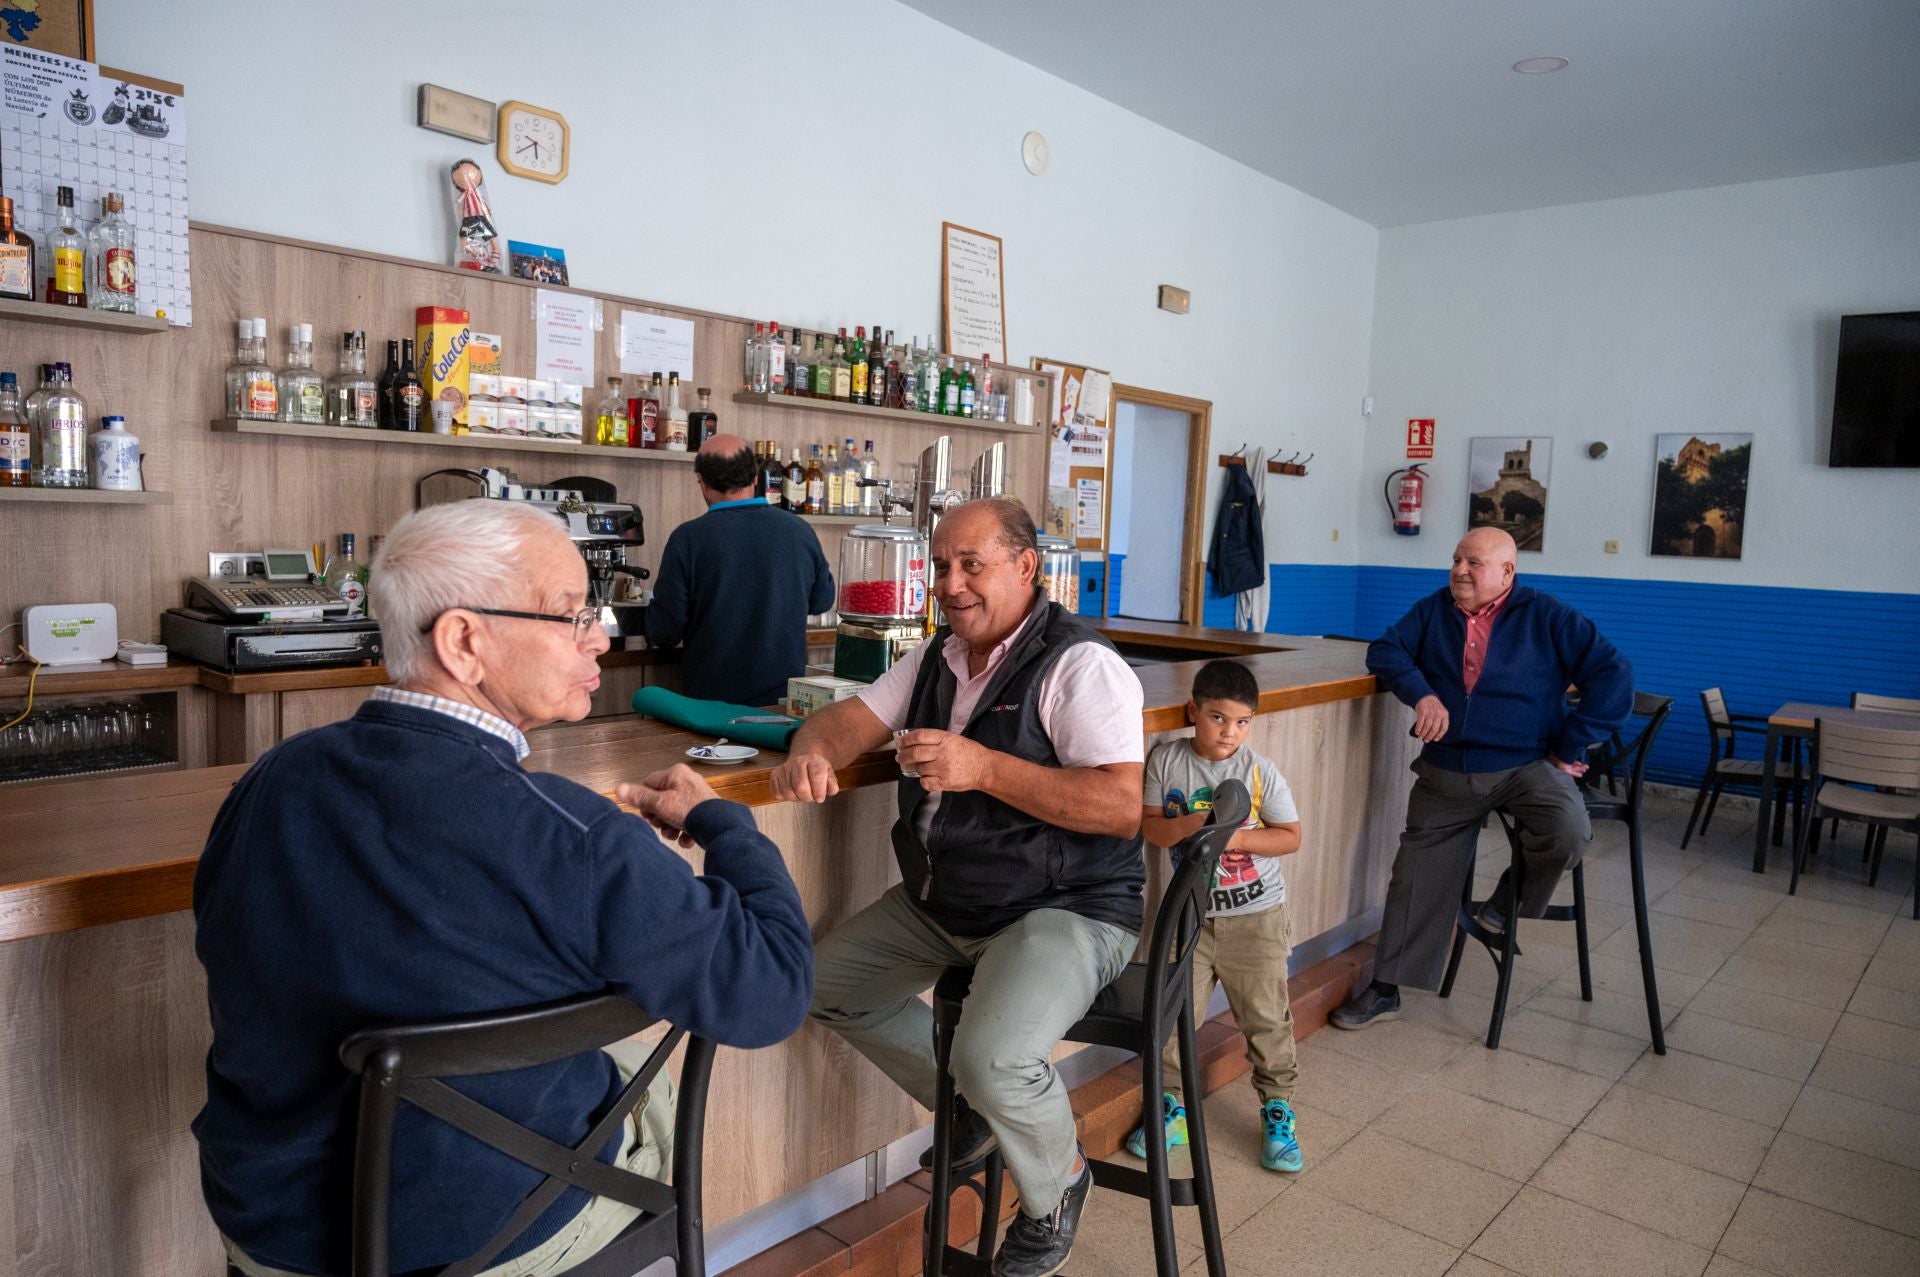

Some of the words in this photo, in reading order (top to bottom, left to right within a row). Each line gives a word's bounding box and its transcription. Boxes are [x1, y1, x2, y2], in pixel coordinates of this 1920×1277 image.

[4, 47, 61, 66] MENESES
[64, 61, 87, 72] F.C.
[5, 59, 31, 68] SORTEO
[58, 70, 78, 79] CESTA
[3, 72, 19, 81] CON
[21, 76, 35, 84] LOS
[36, 79, 51, 87] DOS
[32, 73, 63, 84] NAVIDAD
[4, 79, 39, 92] ÚLTIMOS
[4, 87, 42, 100] NÚMEROS
[5, 102, 34, 113] Navidad
[13, 96, 38, 106] Lotería
[433, 327, 470, 382] ColaCao
[51, 418, 85, 430] LARIOS
[1407, 449, 1432, 458] EXTINTOR
